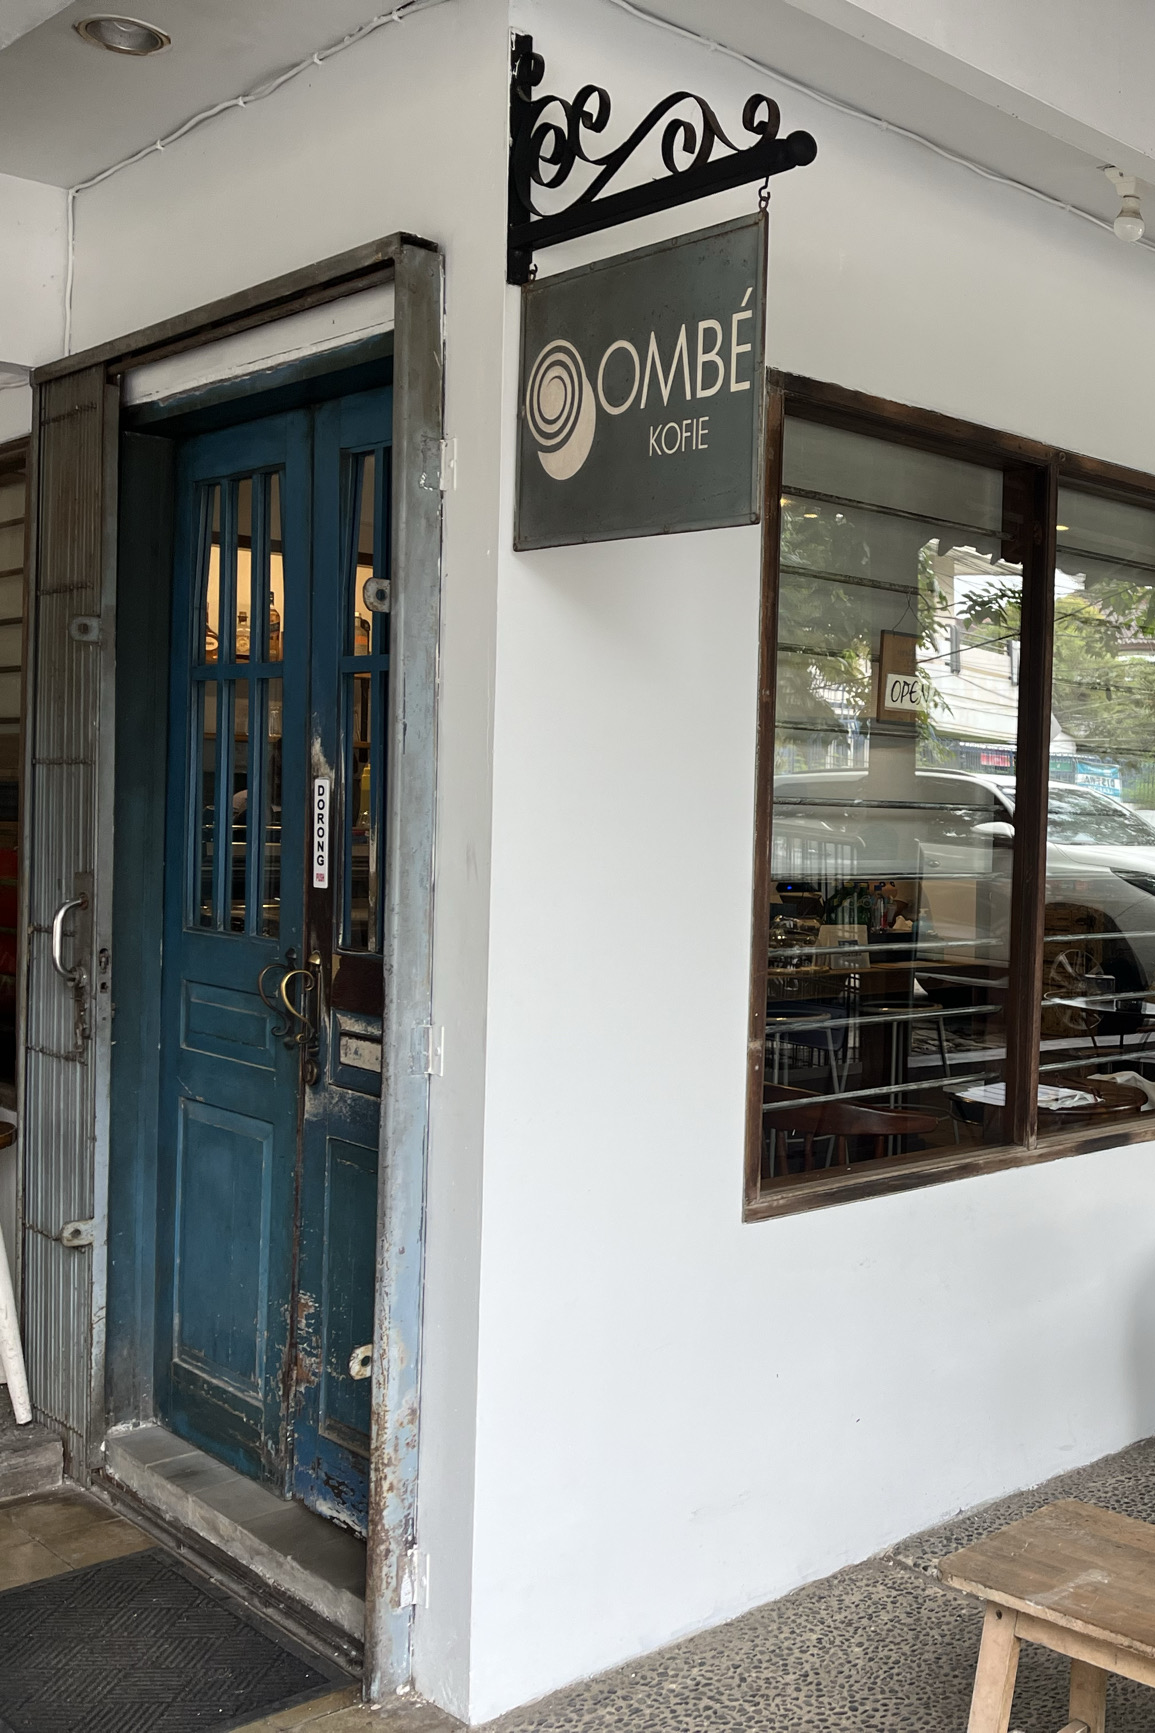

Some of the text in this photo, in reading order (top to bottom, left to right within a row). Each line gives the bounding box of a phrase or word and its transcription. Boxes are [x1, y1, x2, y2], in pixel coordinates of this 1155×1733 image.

[597, 287, 753, 415] OMBÉ
[649, 416, 709, 457] KOFIE
[890, 680, 931, 705] OPEN
[317, 785, 325, 866] DORONG
